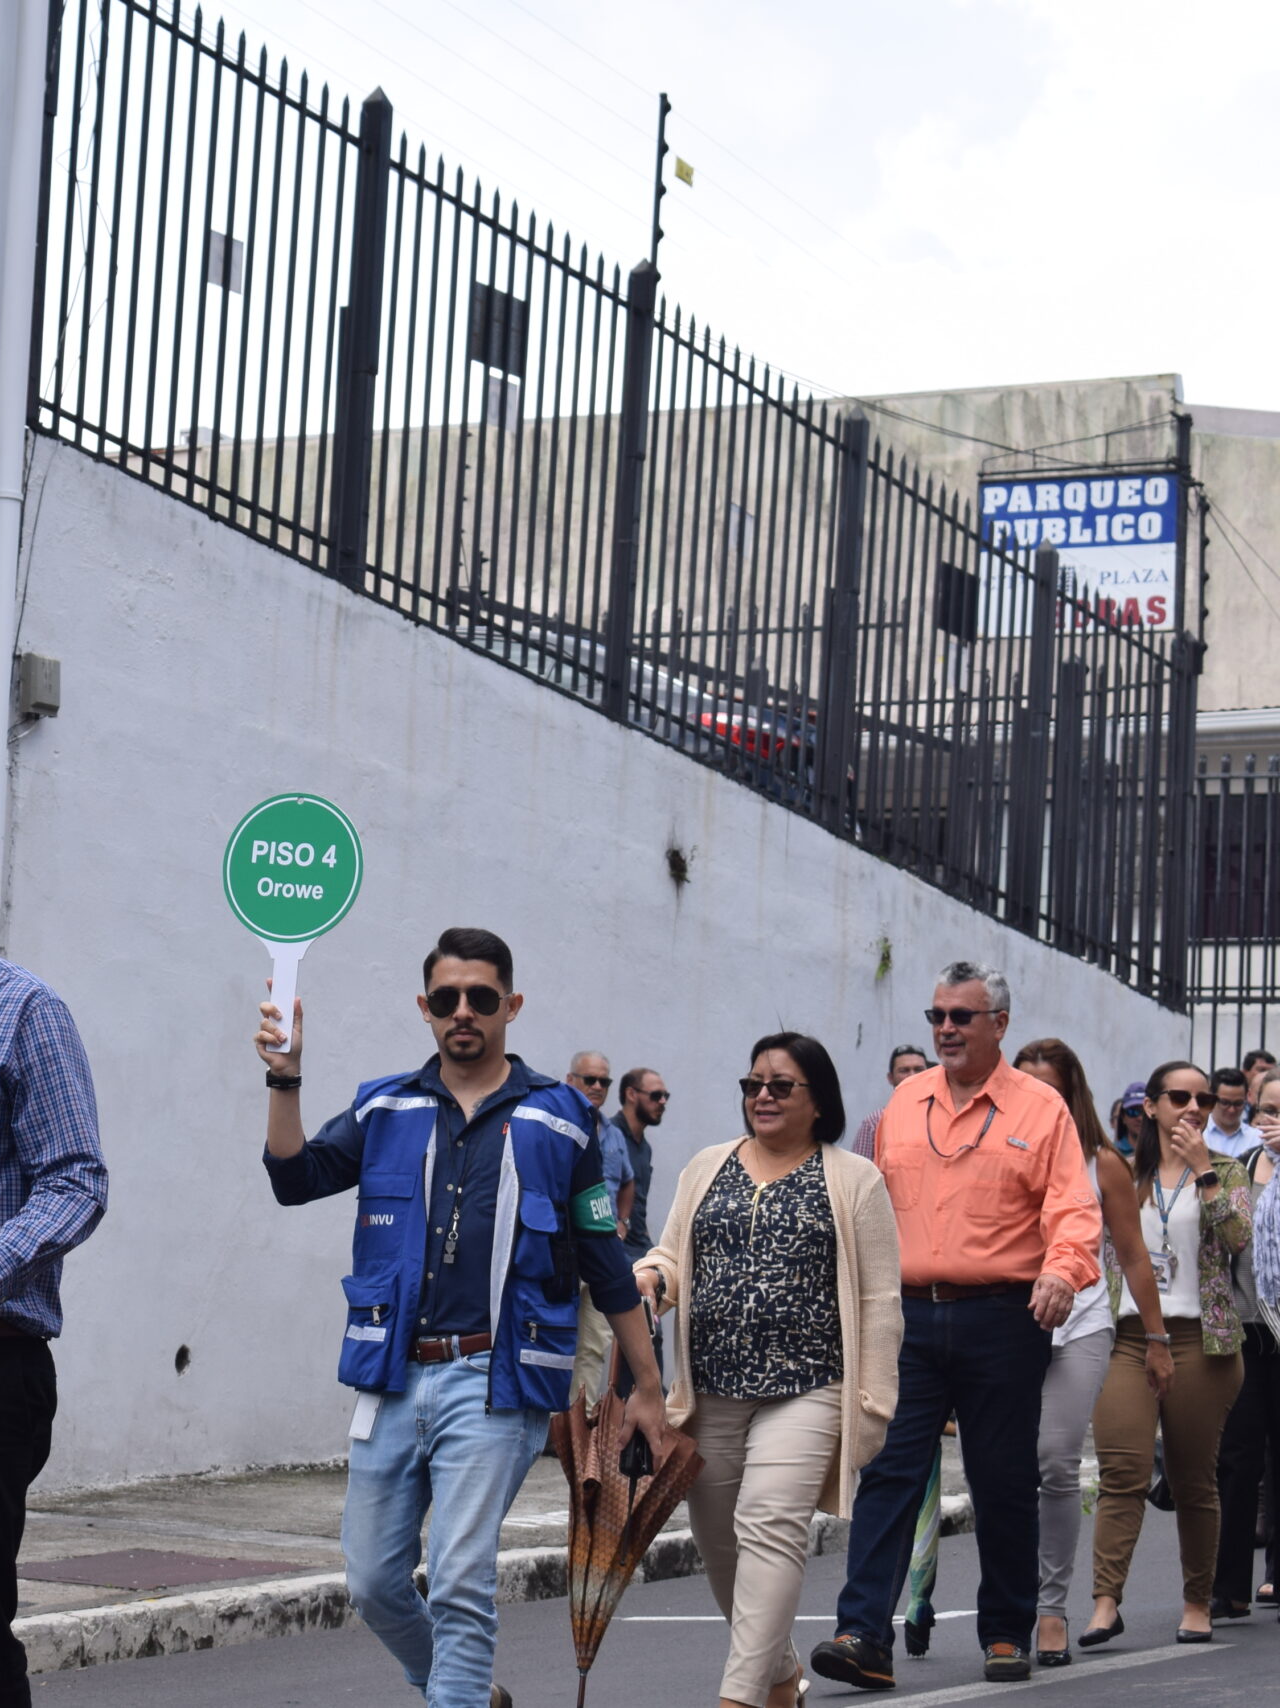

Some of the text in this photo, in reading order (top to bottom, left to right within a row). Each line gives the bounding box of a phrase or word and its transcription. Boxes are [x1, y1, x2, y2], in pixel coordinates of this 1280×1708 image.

[982, 477, 1169, 514] PARQUEO
[989, 512, 1162, 547] PUBLICO
[1099, 567, 1169, 585] PLAZA
[251, 839, 337, 869] PISO 4
[257, 876, 324, 900] Orowe
[369, 1213, 394, 1226] INVU
